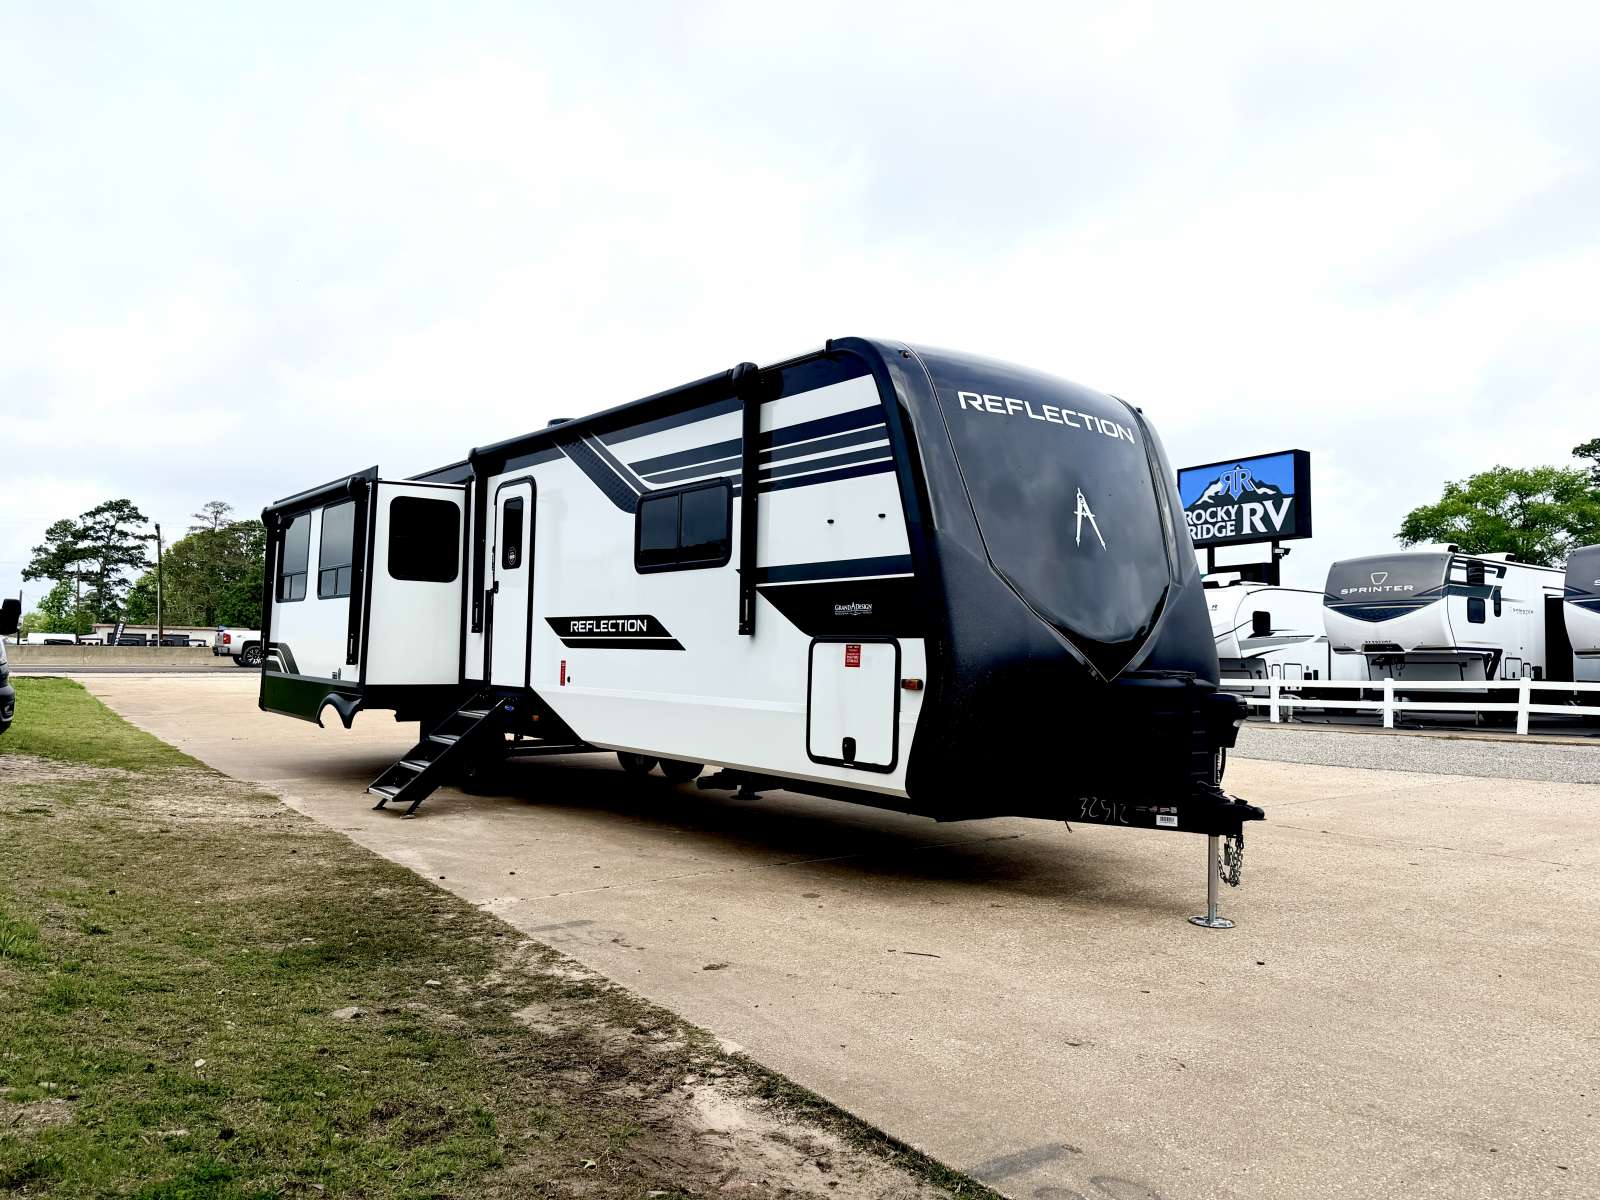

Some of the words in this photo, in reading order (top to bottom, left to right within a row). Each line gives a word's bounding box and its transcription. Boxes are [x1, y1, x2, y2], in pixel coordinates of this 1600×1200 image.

[957, 391, 1135, 444] REFLECTION
[1185, 505, 1238, 525] ROCKY
[1241, 497, 1293, 534] RV
[1190, 521, 1236, 540] RIDGE
[1340, 585, 1414, 595] SPRINTER
[570, 619, 647, 632] REFLECTION
